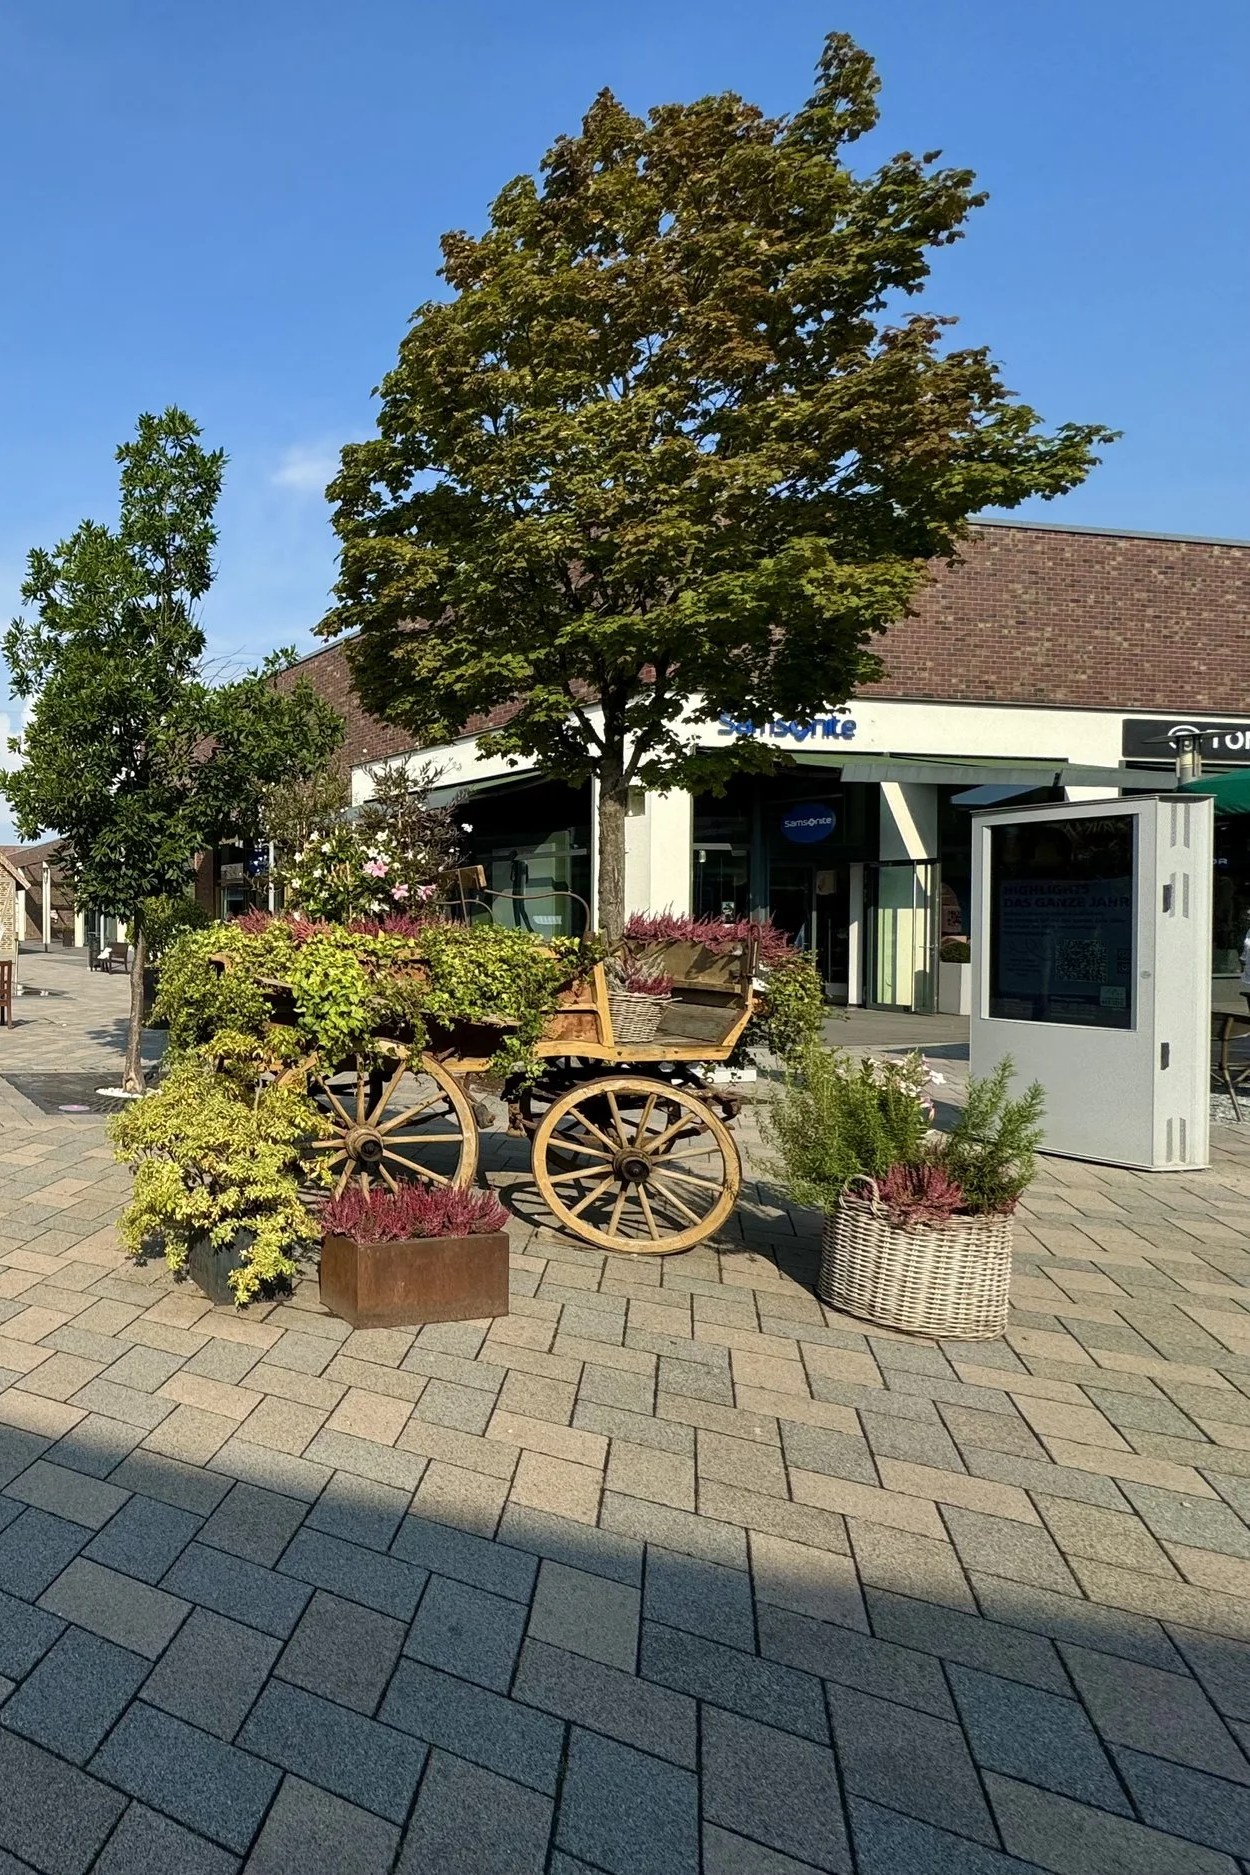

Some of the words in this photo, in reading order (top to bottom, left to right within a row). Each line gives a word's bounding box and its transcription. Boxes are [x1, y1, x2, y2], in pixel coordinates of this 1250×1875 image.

[784, 816, 832, 828] Samsonite
[1003, 884, 1090, 896] HIGHLIGHTS
[1003, 896, 1031, 908] DAS
[1035, 896, 1085, 908] GANZE
[1088, 896, 1131, 908] JAHR
